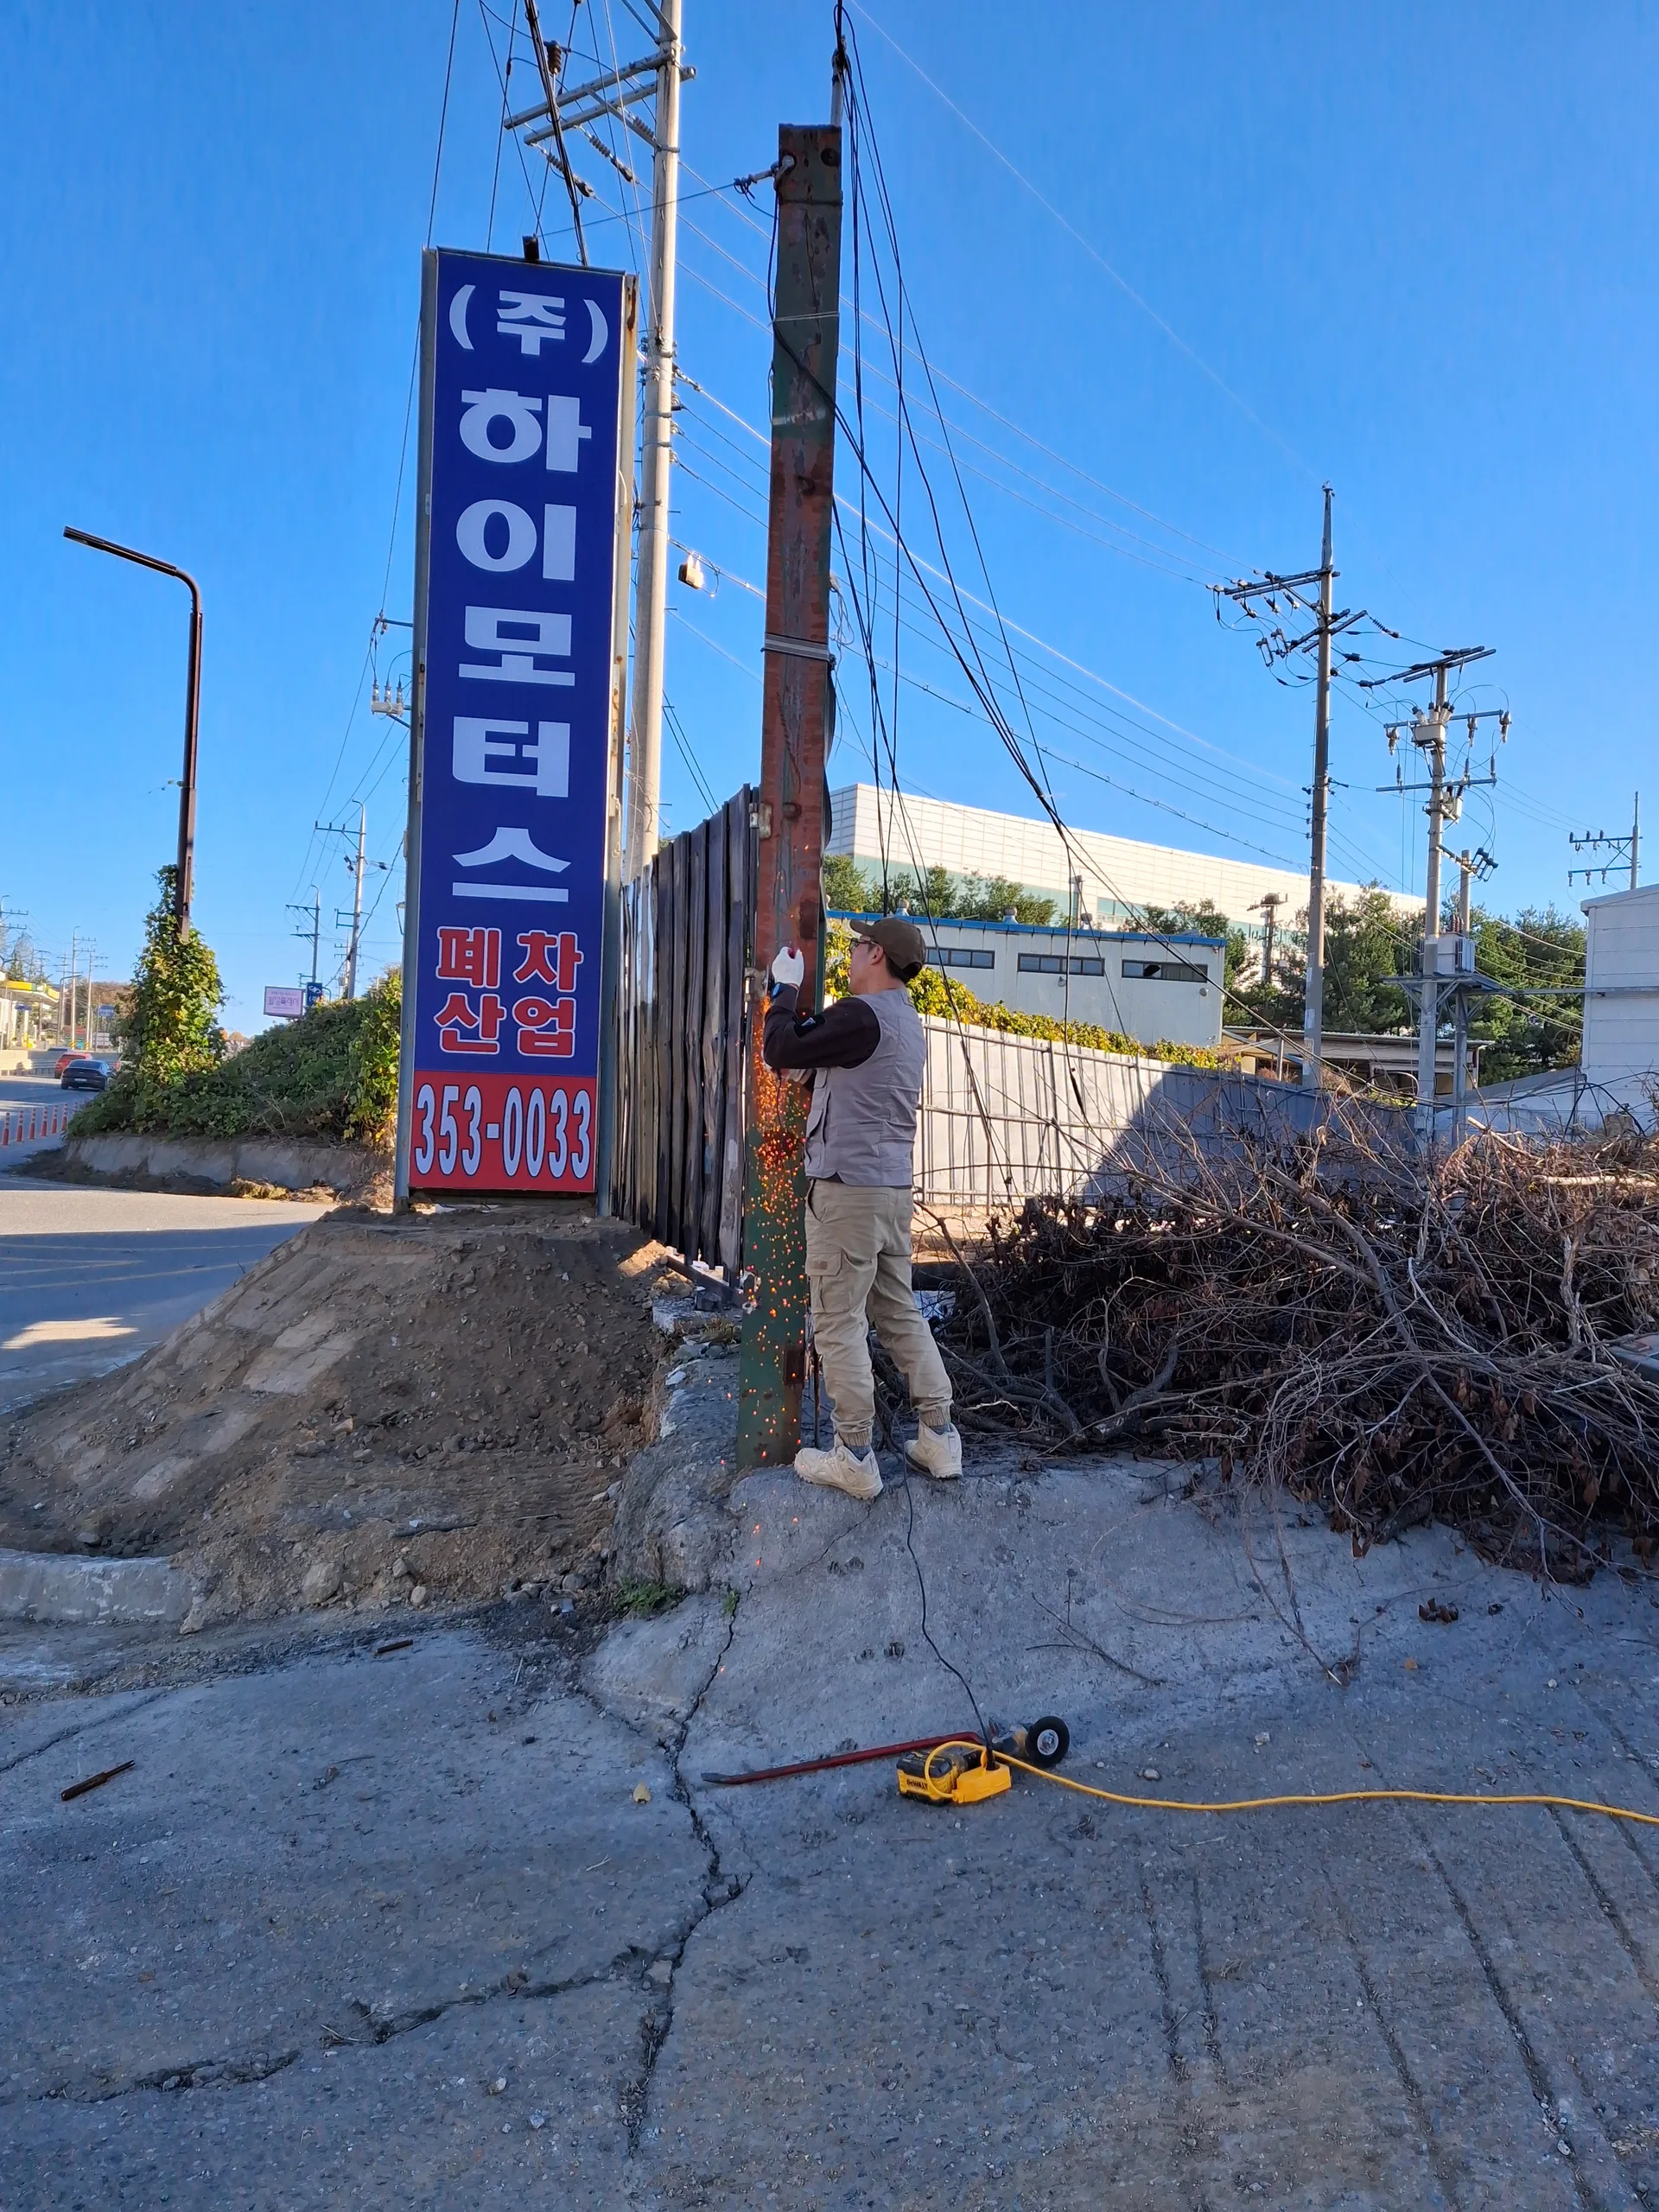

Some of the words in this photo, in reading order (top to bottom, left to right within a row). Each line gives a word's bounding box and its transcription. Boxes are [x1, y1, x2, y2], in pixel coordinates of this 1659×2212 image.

[449, 284, 609, 364] (주)
[452, 388, 592, 902] 하이모터스
[435, 926, 584, 992] 폐차
[434, 993, 576, 1058] 산업
[414, 1084, 592, 1179] 353-0033
